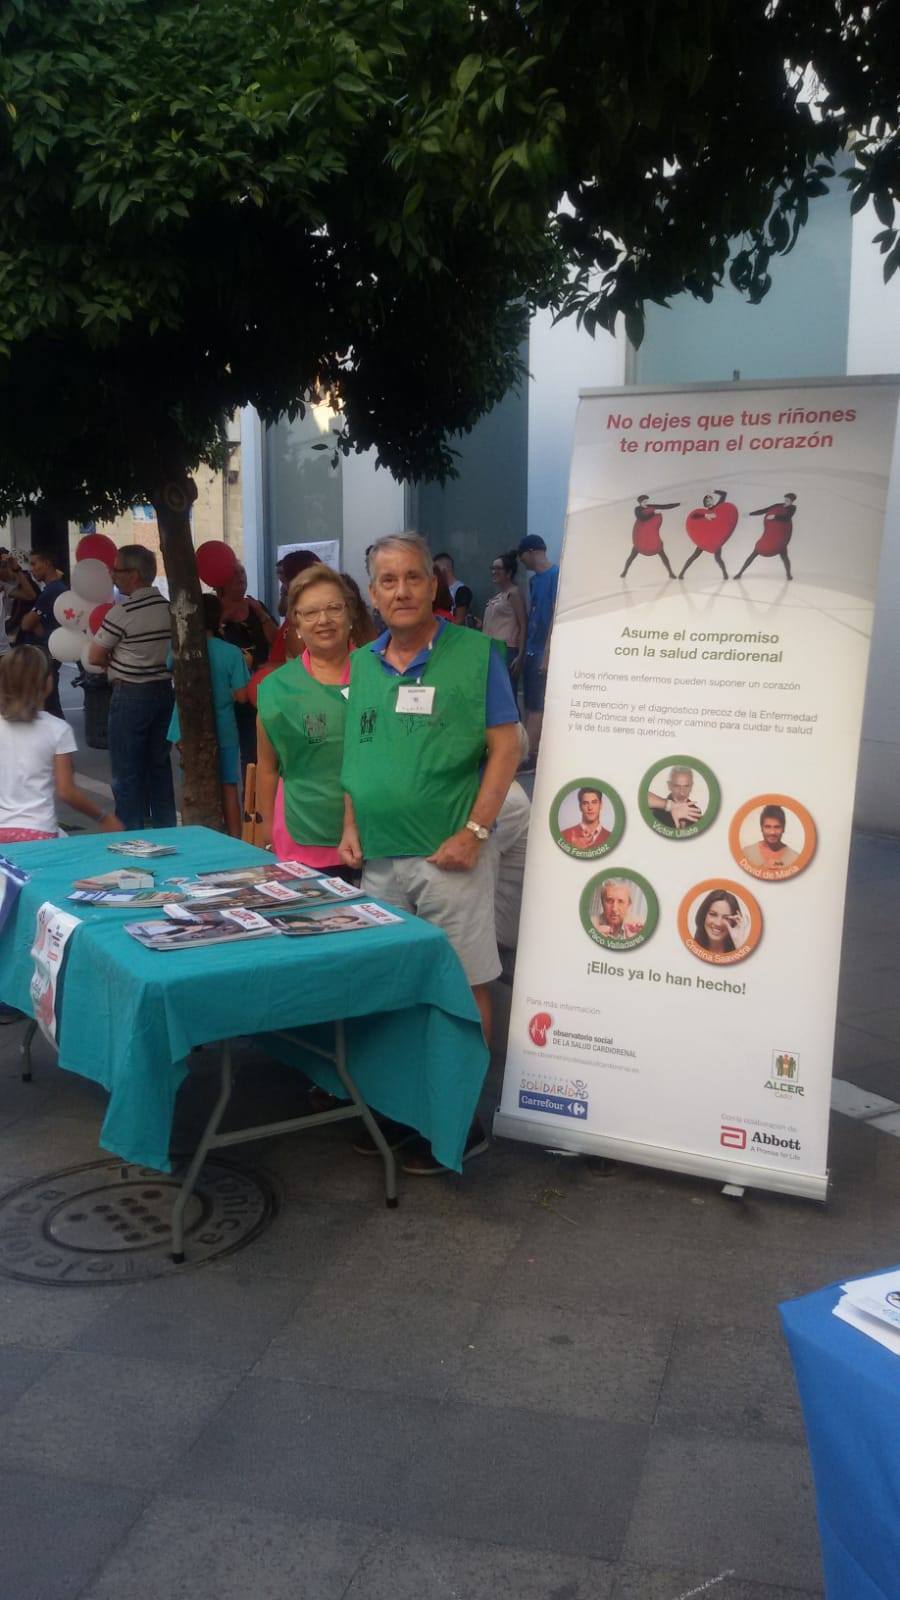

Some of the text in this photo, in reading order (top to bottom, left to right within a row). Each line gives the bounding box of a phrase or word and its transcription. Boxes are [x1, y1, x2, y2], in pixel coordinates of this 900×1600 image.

[606, 407, 857, 432] No dejes que tus riñones
[620, 431, 834, 455] te rompan el corazón
[620, 626, 780, 645] Asume el compromiso
[614, 645, 783, 663] con la salud cardiorenal
[573, 671, 596, 680] Unos
[630, 674, 672, 685] enfermos
[673, 676, 707, 687] pueden
[709, 679, 746, 689] suponer
[748, 680, 761, 688] un
[570, 699, 581, 708] La
[638, 703, 646, 712] el
[701, 707, 733, 718] precoz
[734, 709, 747, 718] de
[748, 709, 758, 719] la
[759, 710, 818, 723] Enfermedad
[569, 710, 593, 720] Renal
[629, 715, 646, 723] son
[647, 715, 656, 724] el
[657, 718, 682, 728] mejor
[683, 719, 718, 729] camino
[719, 720, 741, 731] para
[742, 721, 772, 732] cuidar
[774, 724, 785, 733] tu
[786, 725, 813, 735] salud
[583, 723, 596, 732] de
[597, 724, 611, 733] tus
[586, 961, 747, 995] ¡Ellos ya lo han hecho!
[552, 1037, 637, 1058] DE LA SALUD CARDIORENAL
[593, 1035, 614, 1045] social
[763, 1079, 805, 1097] ALCER
[521, 1095, 565, 1110] Carrefour
[751, 1131, 802, 1151] Abbott
